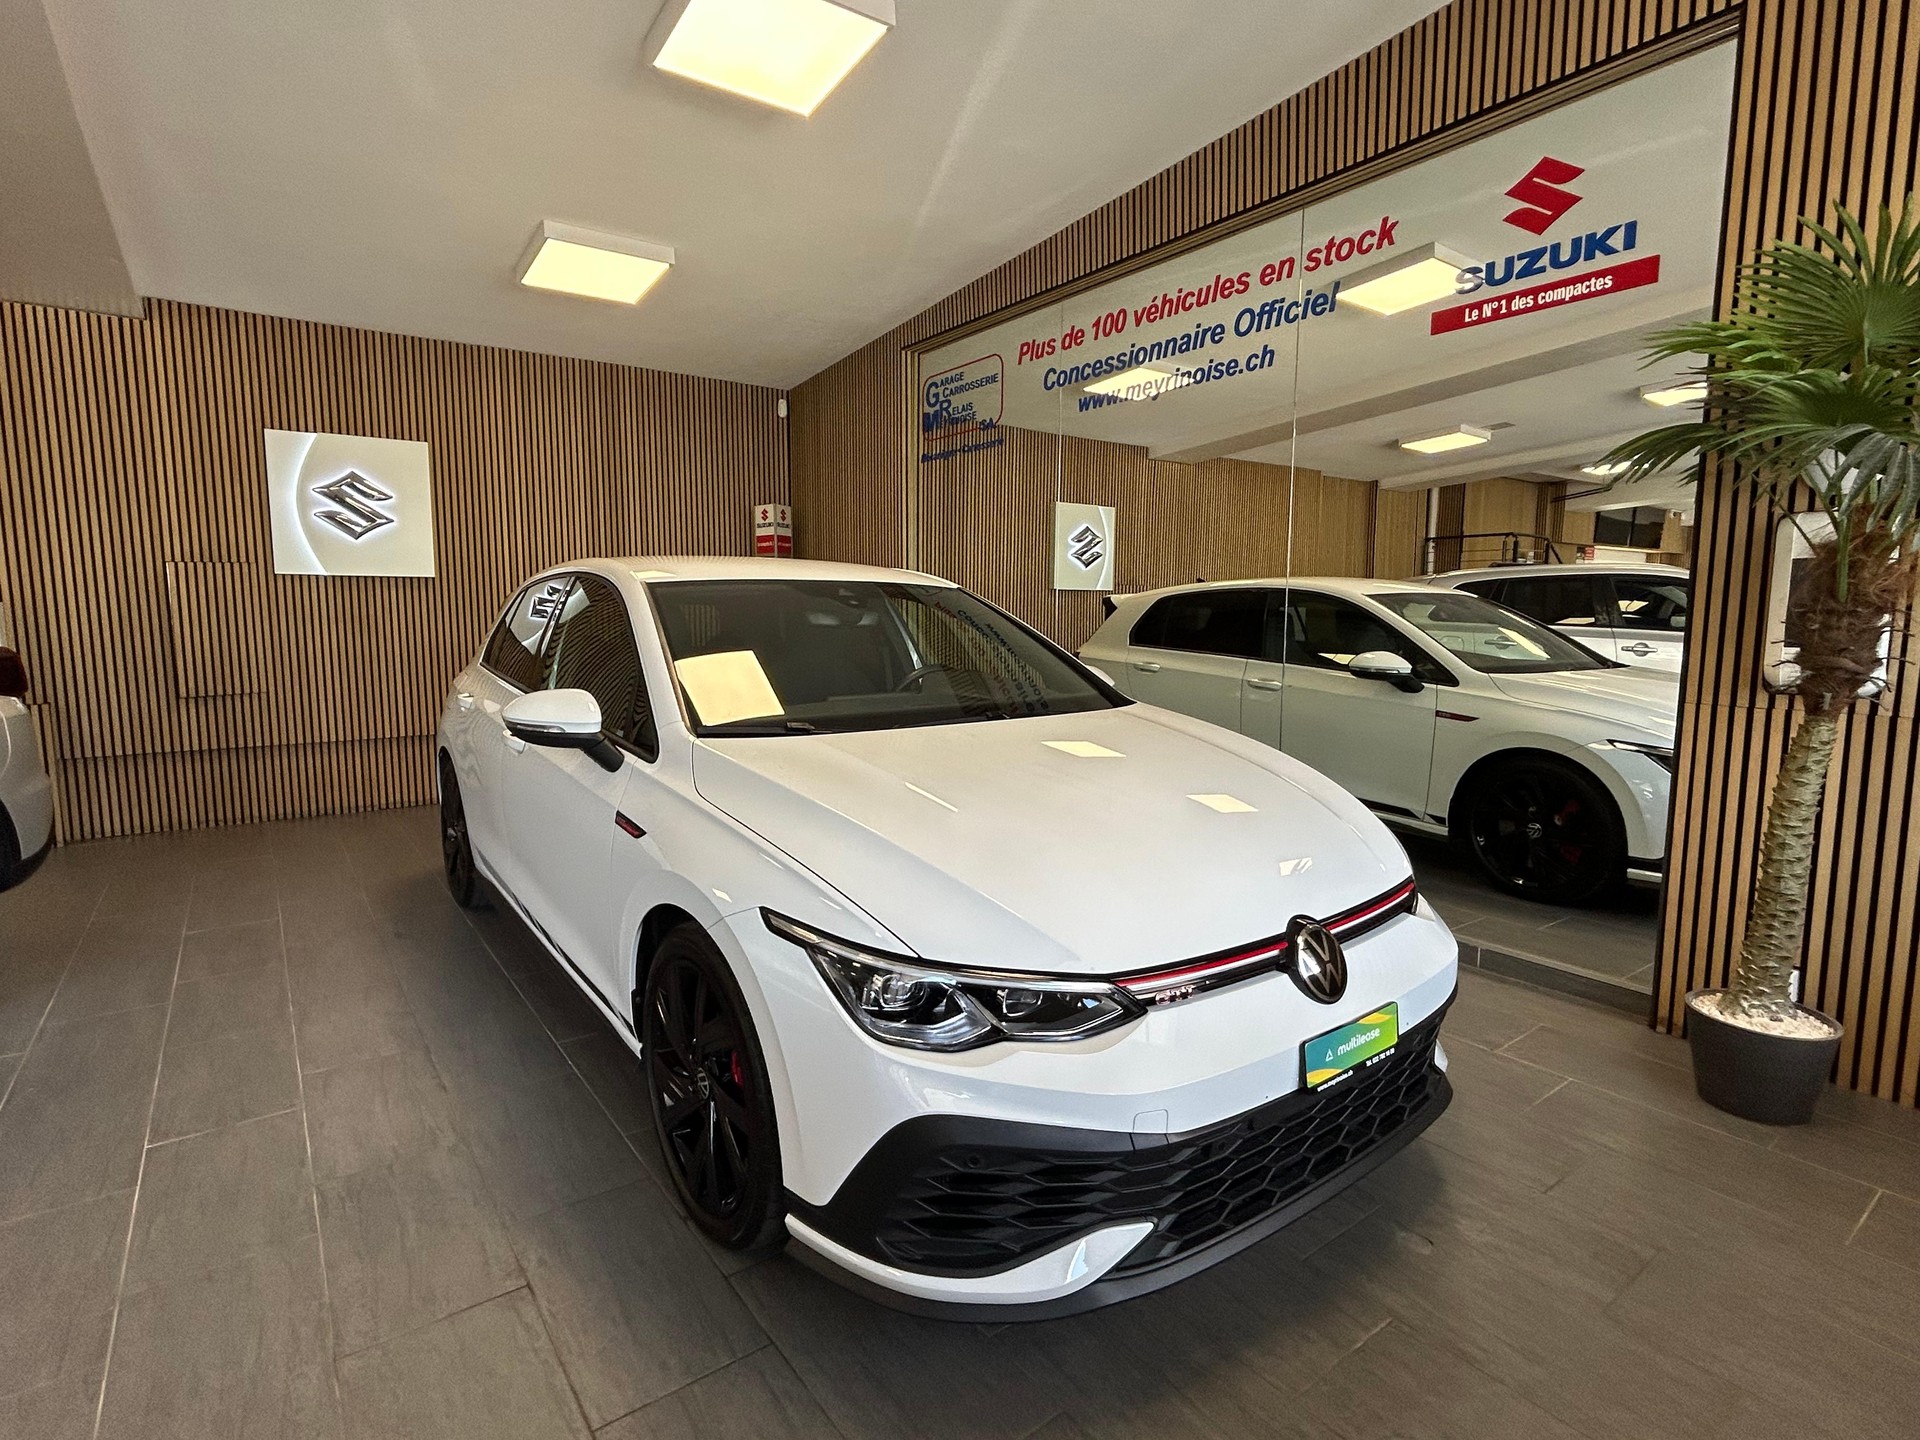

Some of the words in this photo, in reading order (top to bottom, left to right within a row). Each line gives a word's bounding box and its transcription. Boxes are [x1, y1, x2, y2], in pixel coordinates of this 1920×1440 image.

[1017, 339, 1057, 366] Plus
[1060, 325, 1085, 351] de
[1091, 308, 1128, 341] 100
[1133, 271, 1252, 328] véhicules
[1259, 256, 1296, 287] en
[1303, 216, 1400, 273] stock
[1455, 219, 1638, 295] SUZUKI
[1464, 307, 1479, 323] Le
[1511, 293, 1534, 312] des
[1537, 275, 1613, 305] compactes
[1043, 322, 1226, 391] Concessionnaire
[1234, 280, 1341, 338] Officiel
[942, 373, 999, 398] CARROSSERIE
[1078, 345, 1275, 413] www.meyrinoise.ch
[1337, 1027, 1380, 1056] multilease
